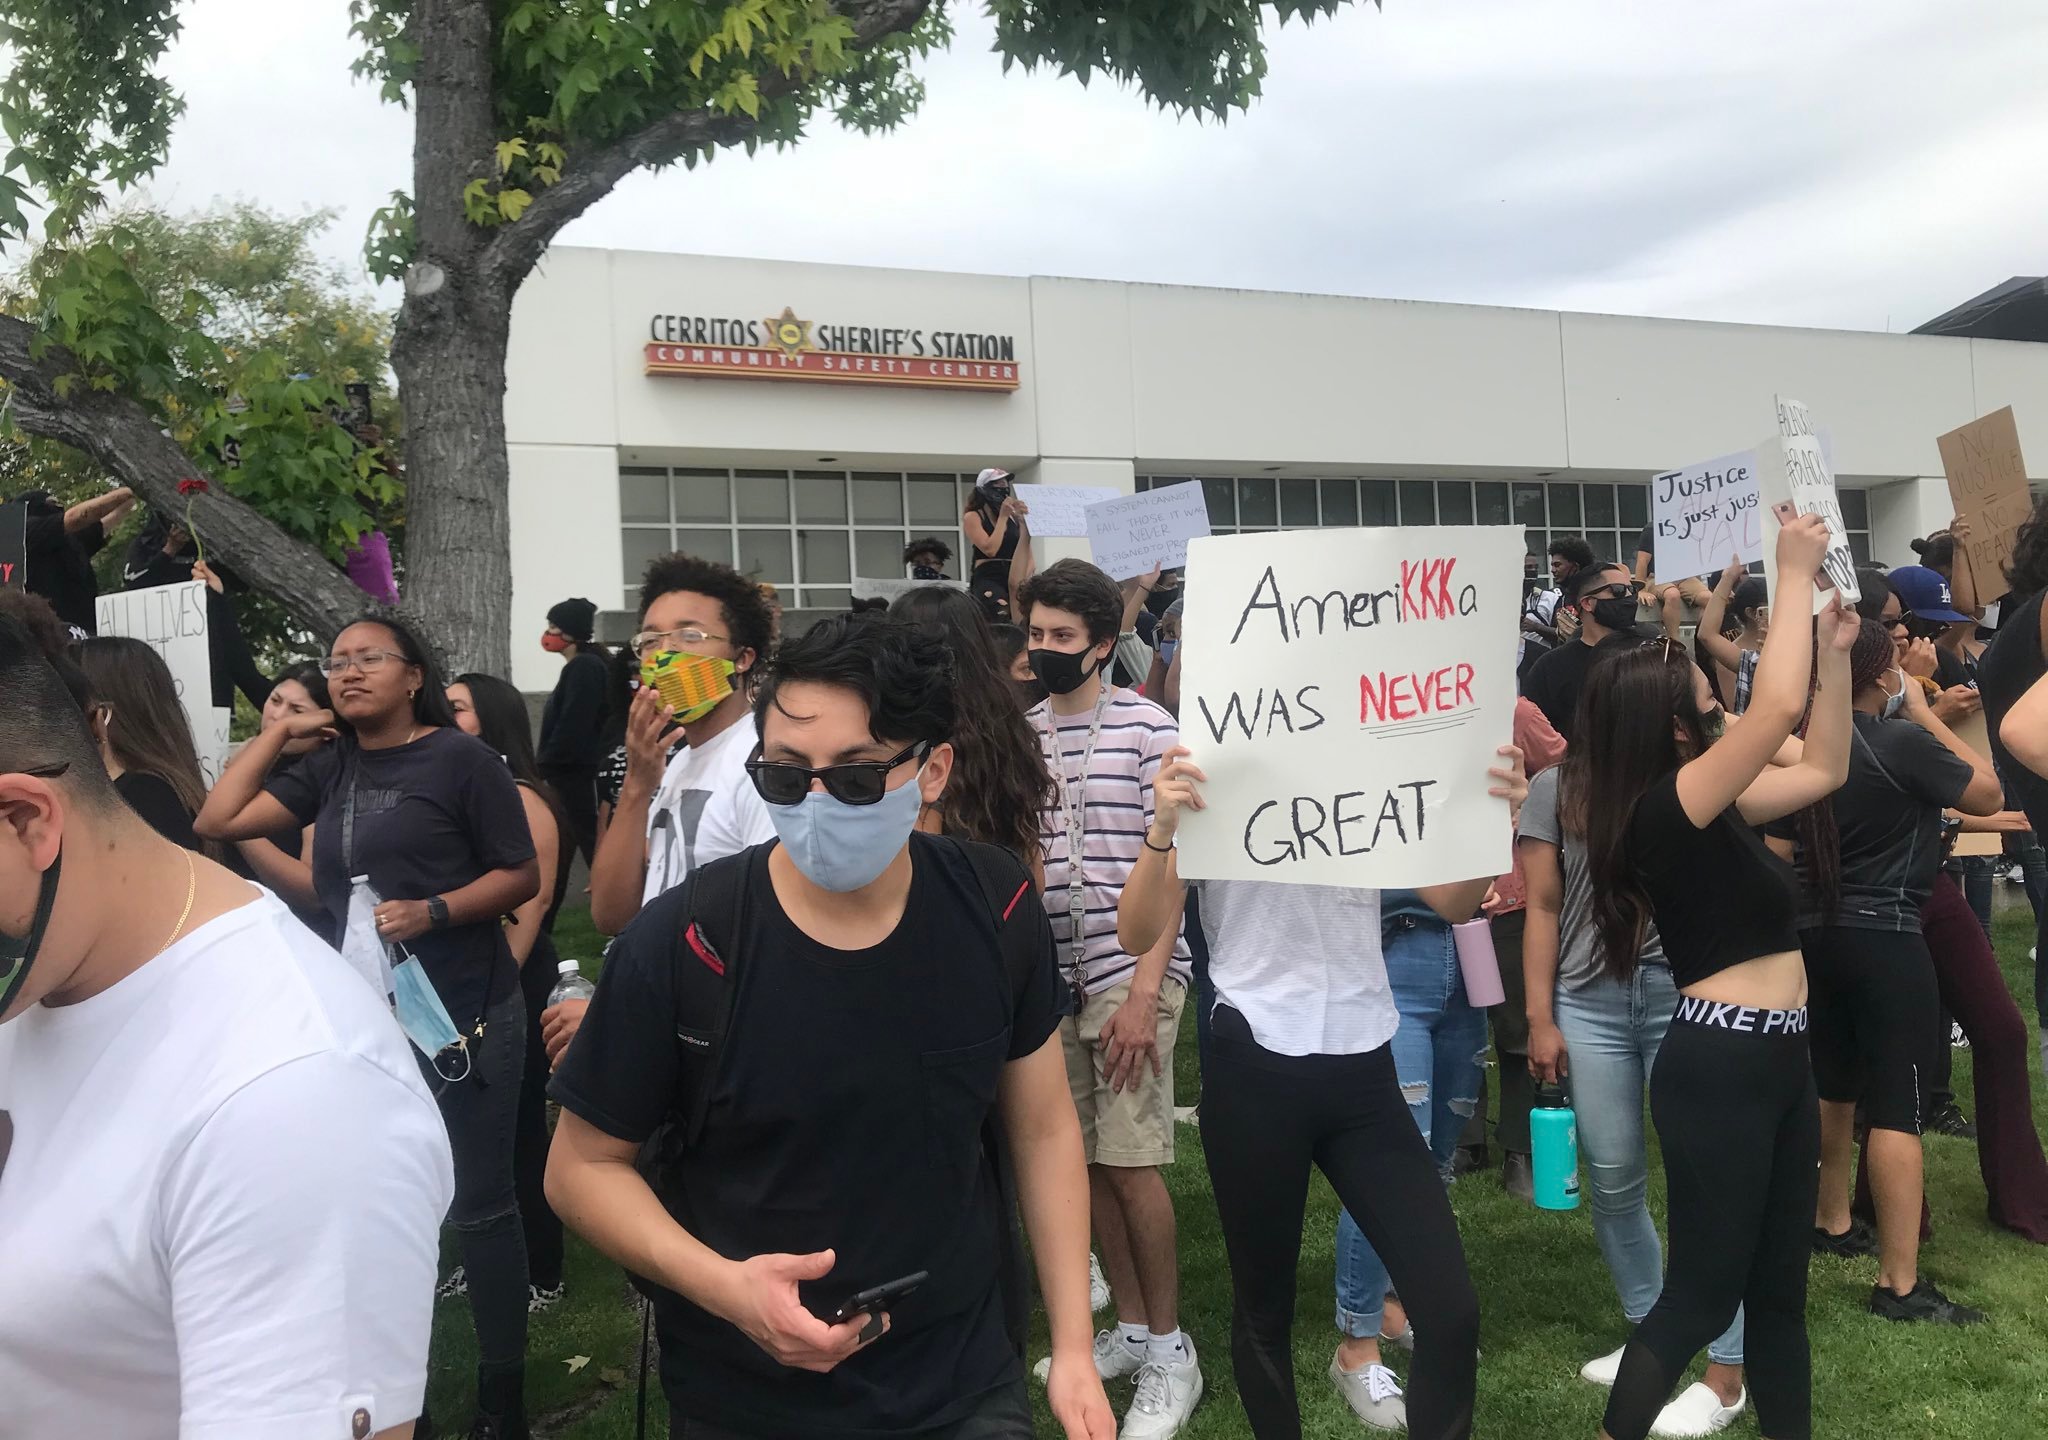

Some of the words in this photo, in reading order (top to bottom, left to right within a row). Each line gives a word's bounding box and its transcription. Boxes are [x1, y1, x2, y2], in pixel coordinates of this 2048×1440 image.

[651, 314, 760, 348] CERRITOS
[818, 324, 924, 357] SHERIFF'S
[931, 331, 1014, 362] STATION
[656, 347, 806, 368] COMMUNITY
[823, 356, 911, 374] SAFETY
[929, 362, 1013, 379] CENTER
[1959, 421, 1995, 462] NO
[1658, 467, 1749, 503] Justice
[1952, 448, 2021, 501] JUSTICE
[1096, 523, 1120, 535] FAIL
[1127, 513, 1165, 529] THOSE
[1170, 510, 1180, 520] IT
[1184, 506, 1206, 517] WAS
[1106, 498, 1148, 516] SYSTEM
[1151, 490, 1191, 506] CANNOT
[1981, 505, 2009, 535] NO
[1129, 523, 1171, 544] NEVER
[1658, 518, 1677, 537] is
[1678, 504, 1719, 540] just
[1095, 545, 1151, 566] DESIGNED
[1973, 527, 2017, 570] PEAC
[0, 562, 14, 583] Y
[1230, 557, 1477, 644] AmeriKKKa
[1940, 583, 1951, 603] LA
[144, 583, 205, 641] LIVES
[1198, 685, 1325, 744] WAS
[1359, 663, 1475, 723] NEVER
[1244, 780, 1437, 866] GREAT
[1677, 996, 1760, 1032] NIKE
[1763, 1005, 1808, 1035] PRO
